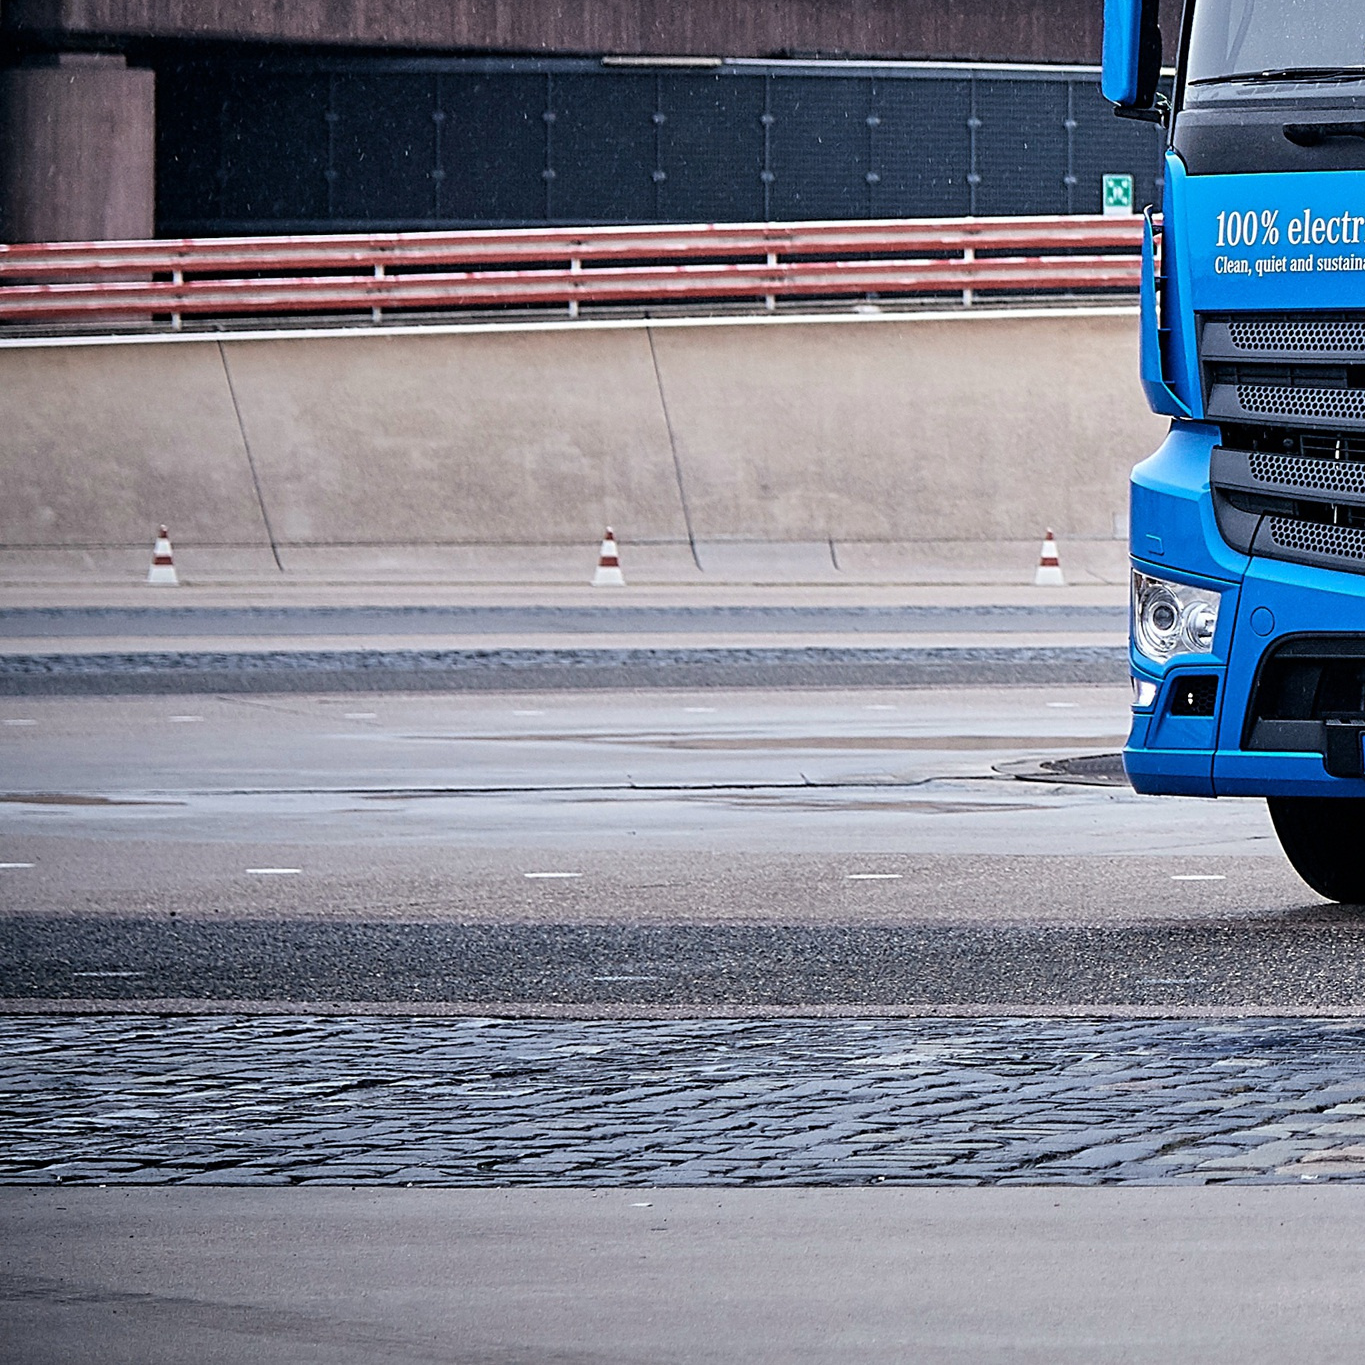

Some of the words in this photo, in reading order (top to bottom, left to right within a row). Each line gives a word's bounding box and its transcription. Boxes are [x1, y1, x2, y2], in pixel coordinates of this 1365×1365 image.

[1215, 209, 1280, 247] 100%
[1215, 256, 1252, 276] Clean,
[1255, 255, 1287, 277] quiet
[1290, 254, 1314, 272] and
